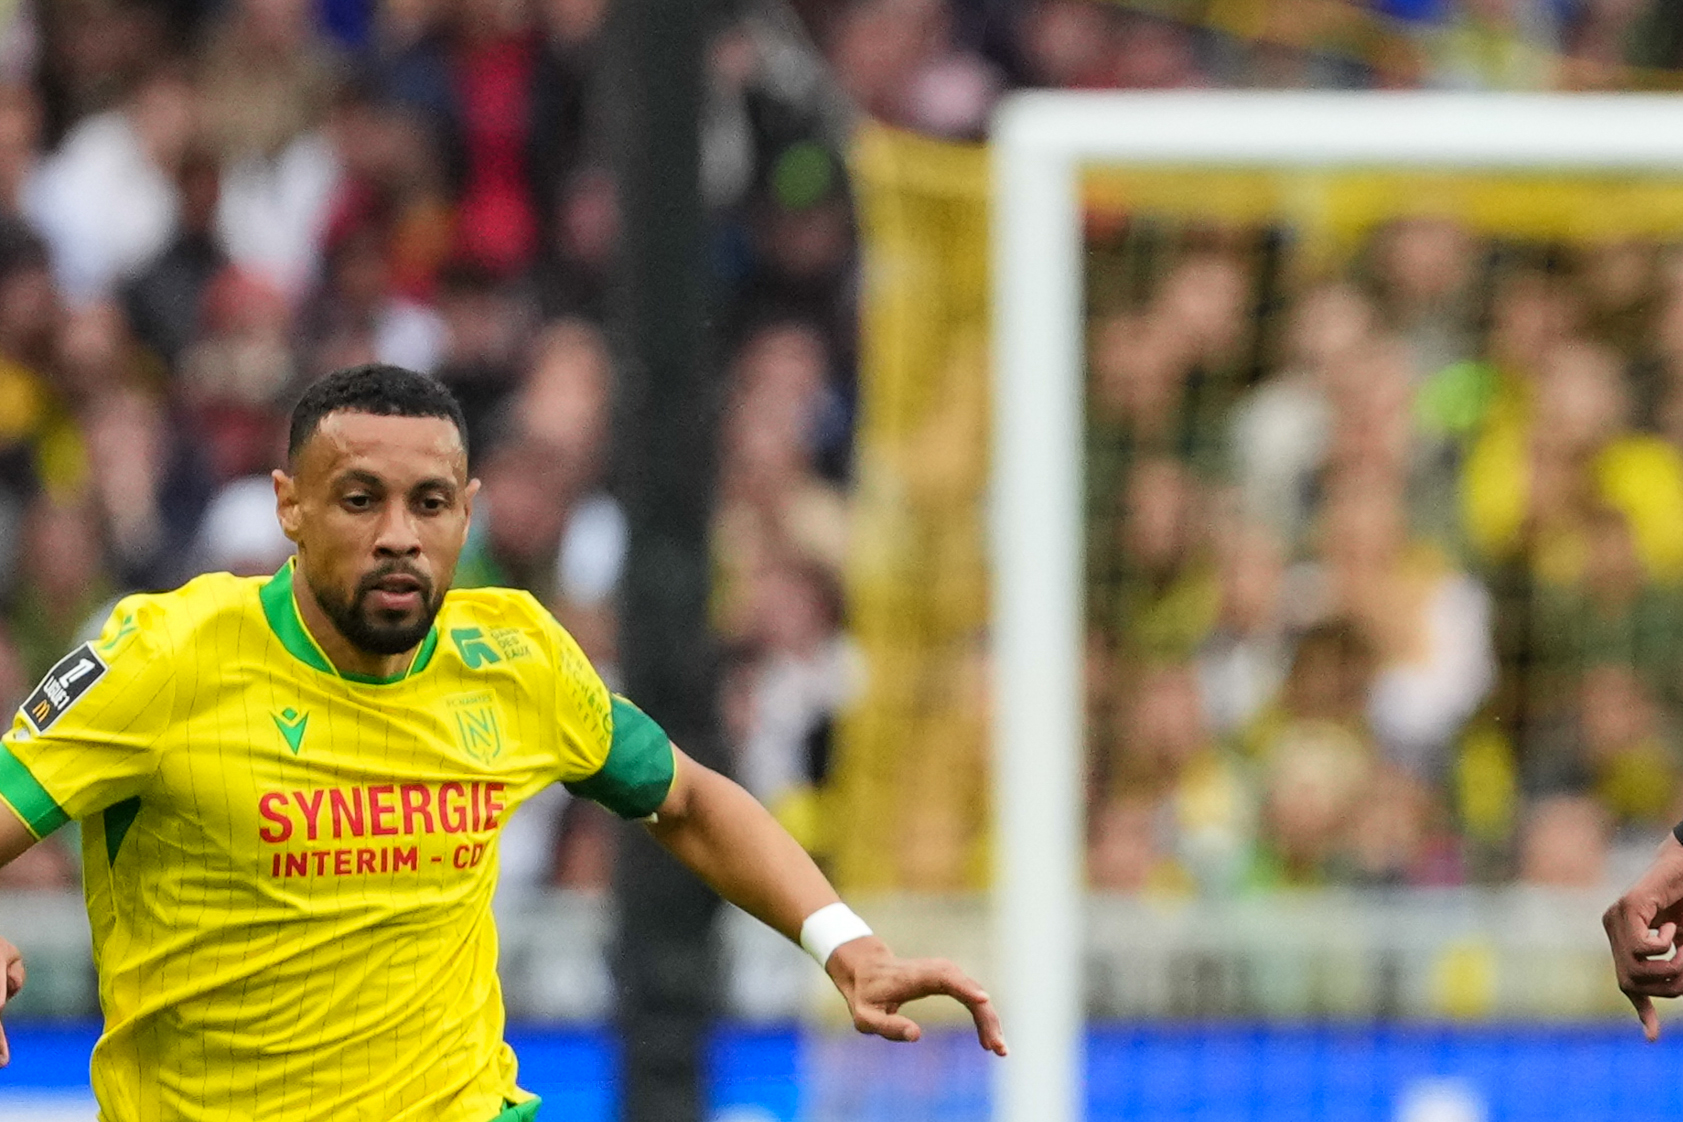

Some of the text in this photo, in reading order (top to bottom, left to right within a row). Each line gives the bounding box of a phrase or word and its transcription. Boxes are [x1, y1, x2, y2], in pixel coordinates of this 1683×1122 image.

[259, 782, 506, 844] SYNERGIE
[271, 846, 418, 878] INTERIM
[453, 842, 485, 870] CD
